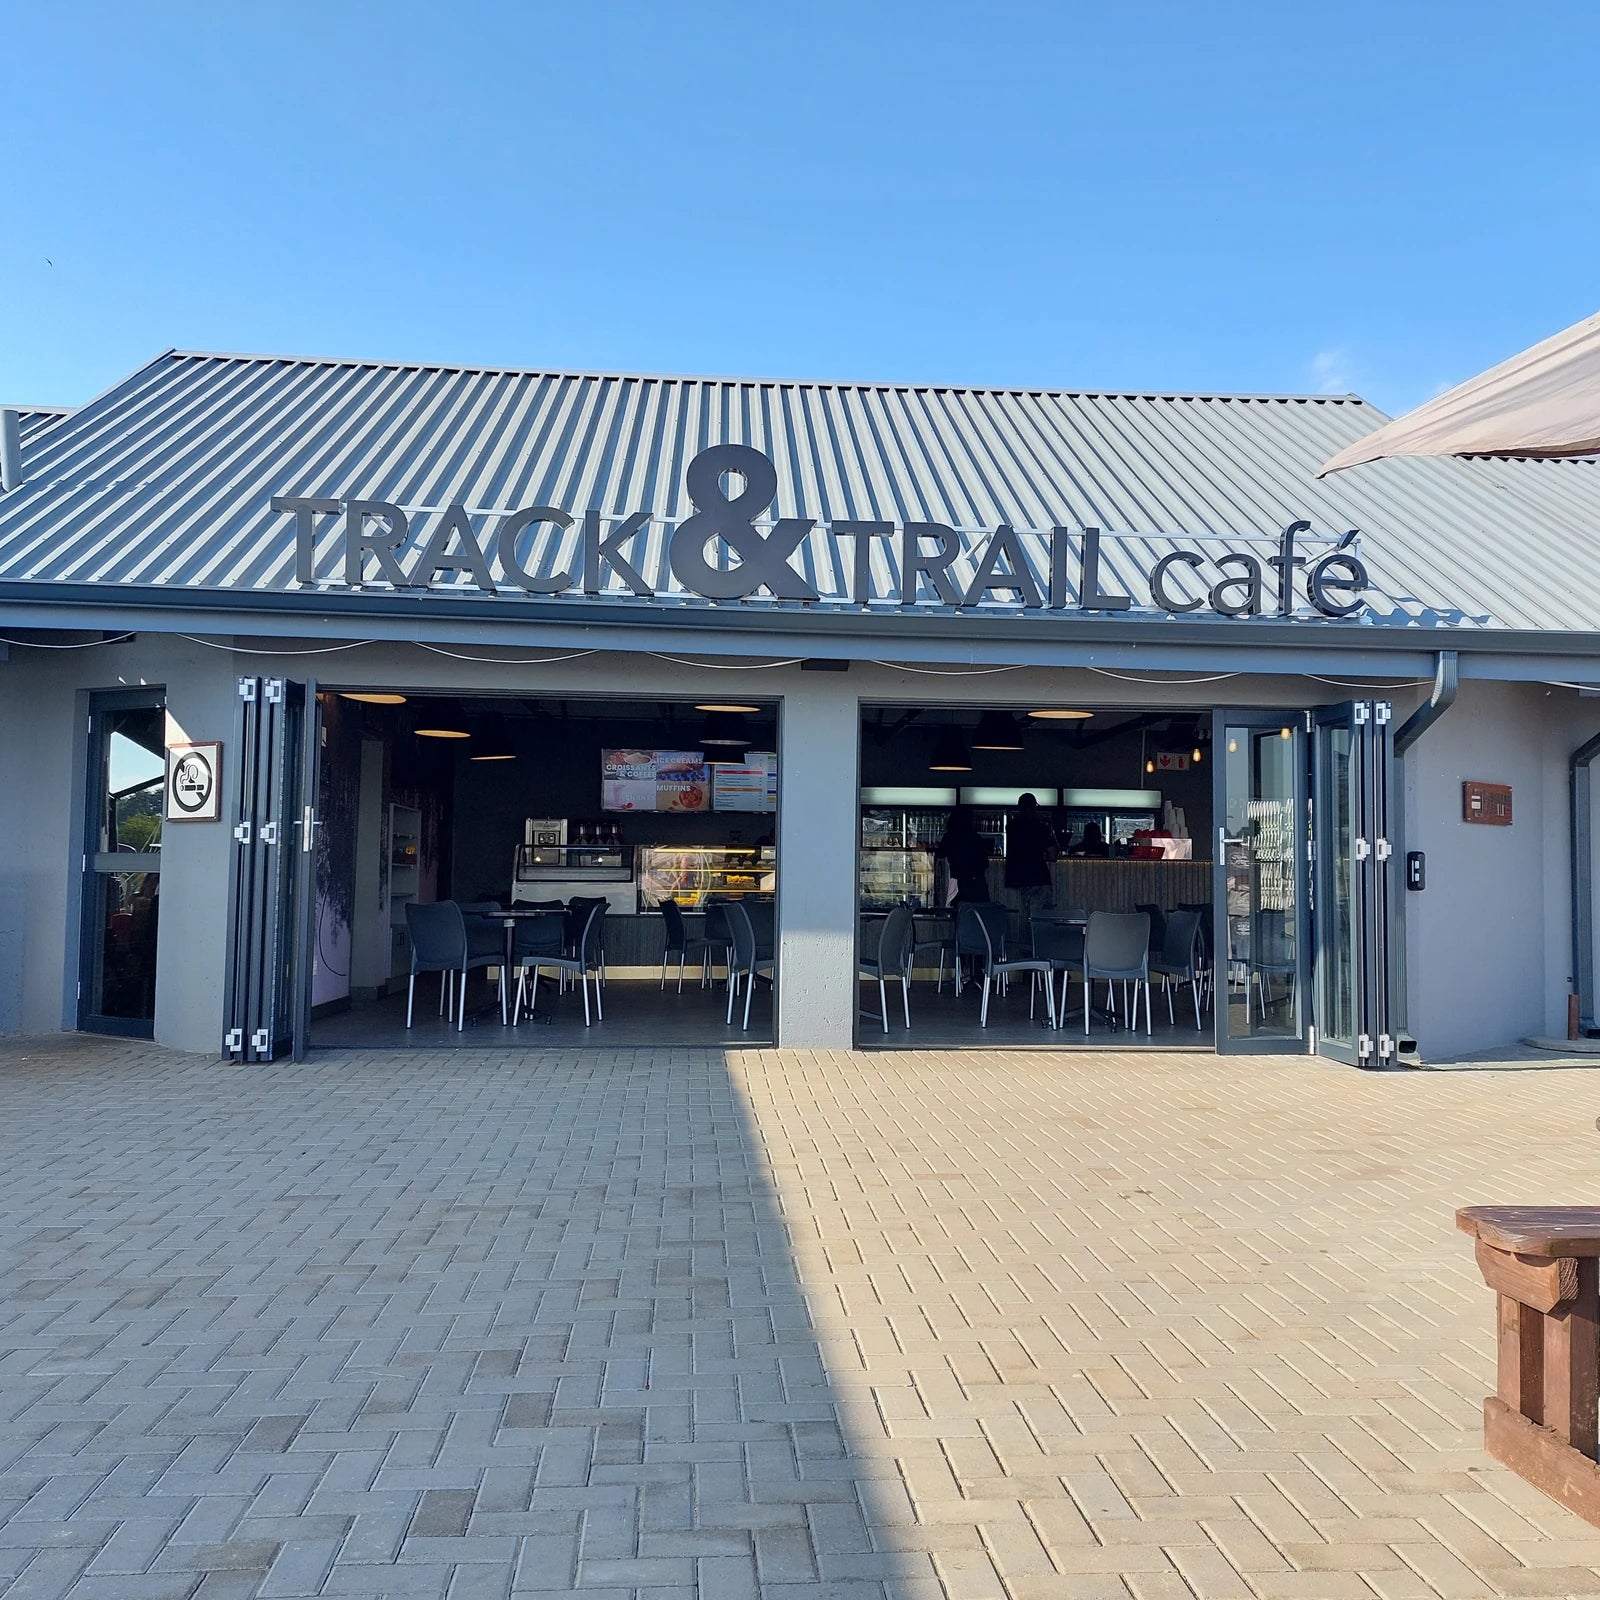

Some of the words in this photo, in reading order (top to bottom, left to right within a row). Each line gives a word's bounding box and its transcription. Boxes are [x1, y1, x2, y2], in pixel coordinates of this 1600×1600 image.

[271, 496, 654, 597] TRACK
[669, 443, 820, 600] &
[831, 519, 1131, 610] TRAIL
[1150, 520, 1369, 616] café
